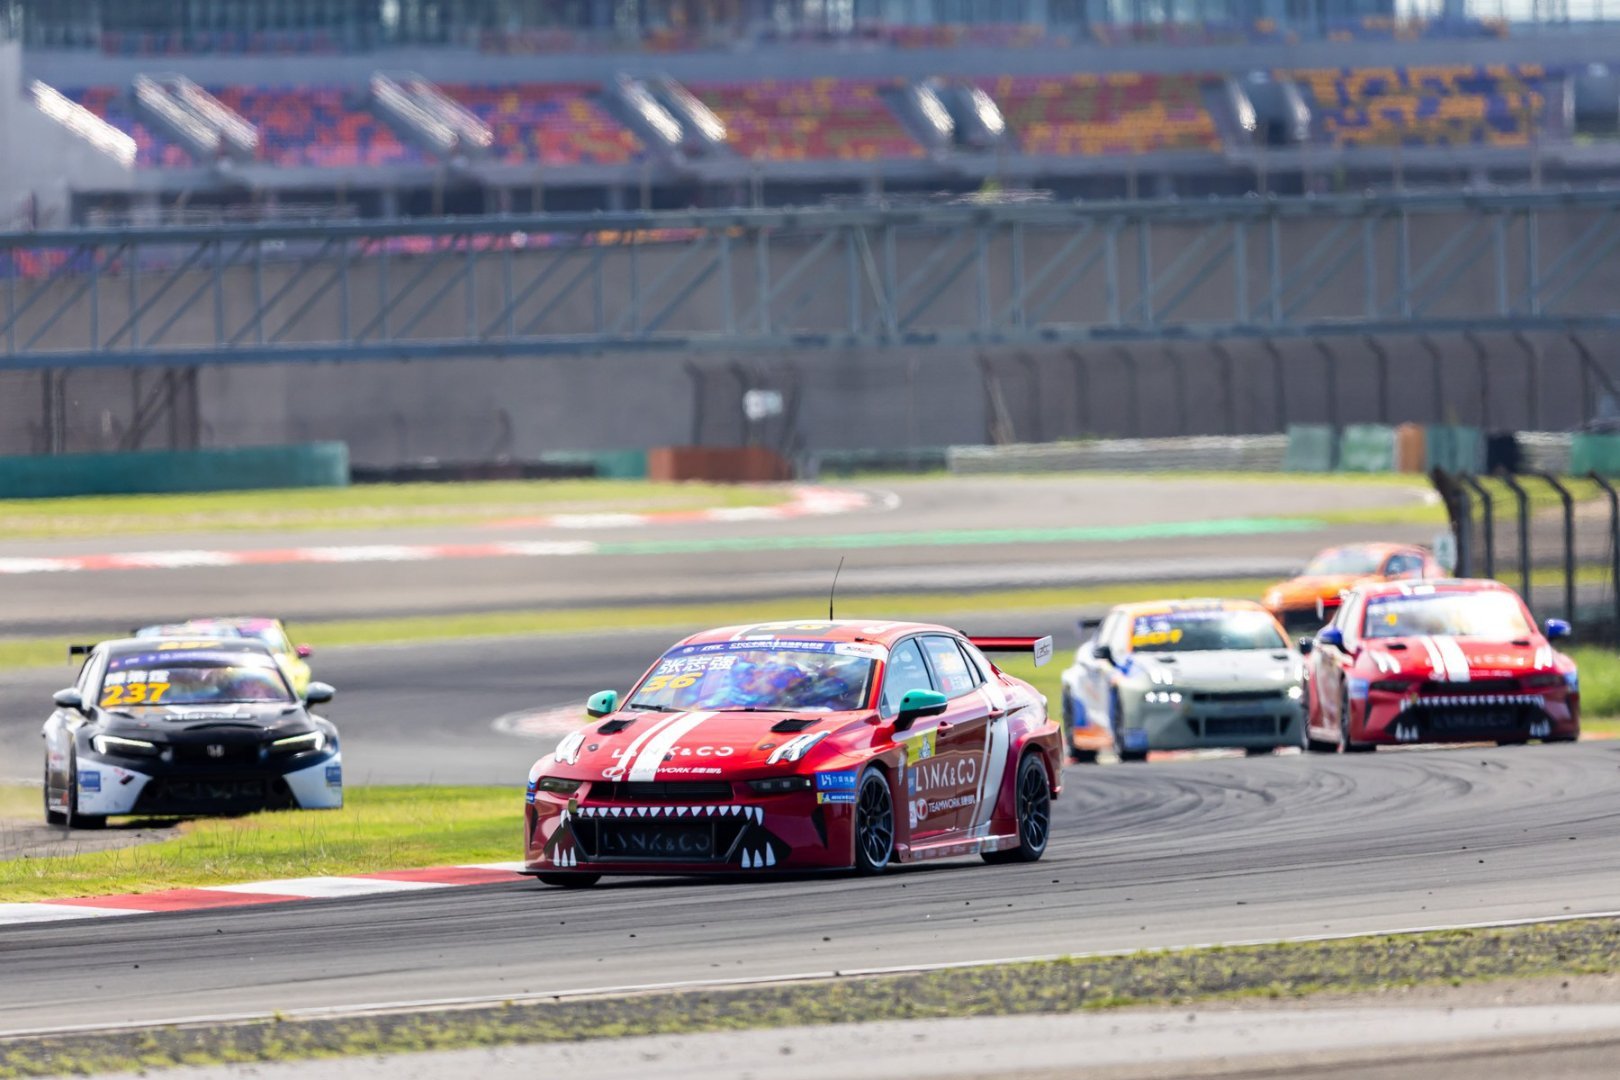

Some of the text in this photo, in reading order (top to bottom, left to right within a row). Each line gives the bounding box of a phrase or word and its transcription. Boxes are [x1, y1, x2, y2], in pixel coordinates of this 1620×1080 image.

[640, 672, 704, 693] 36
[100, 682, 171, 707] 237
[612, 747, 734, 758] LK&CO
